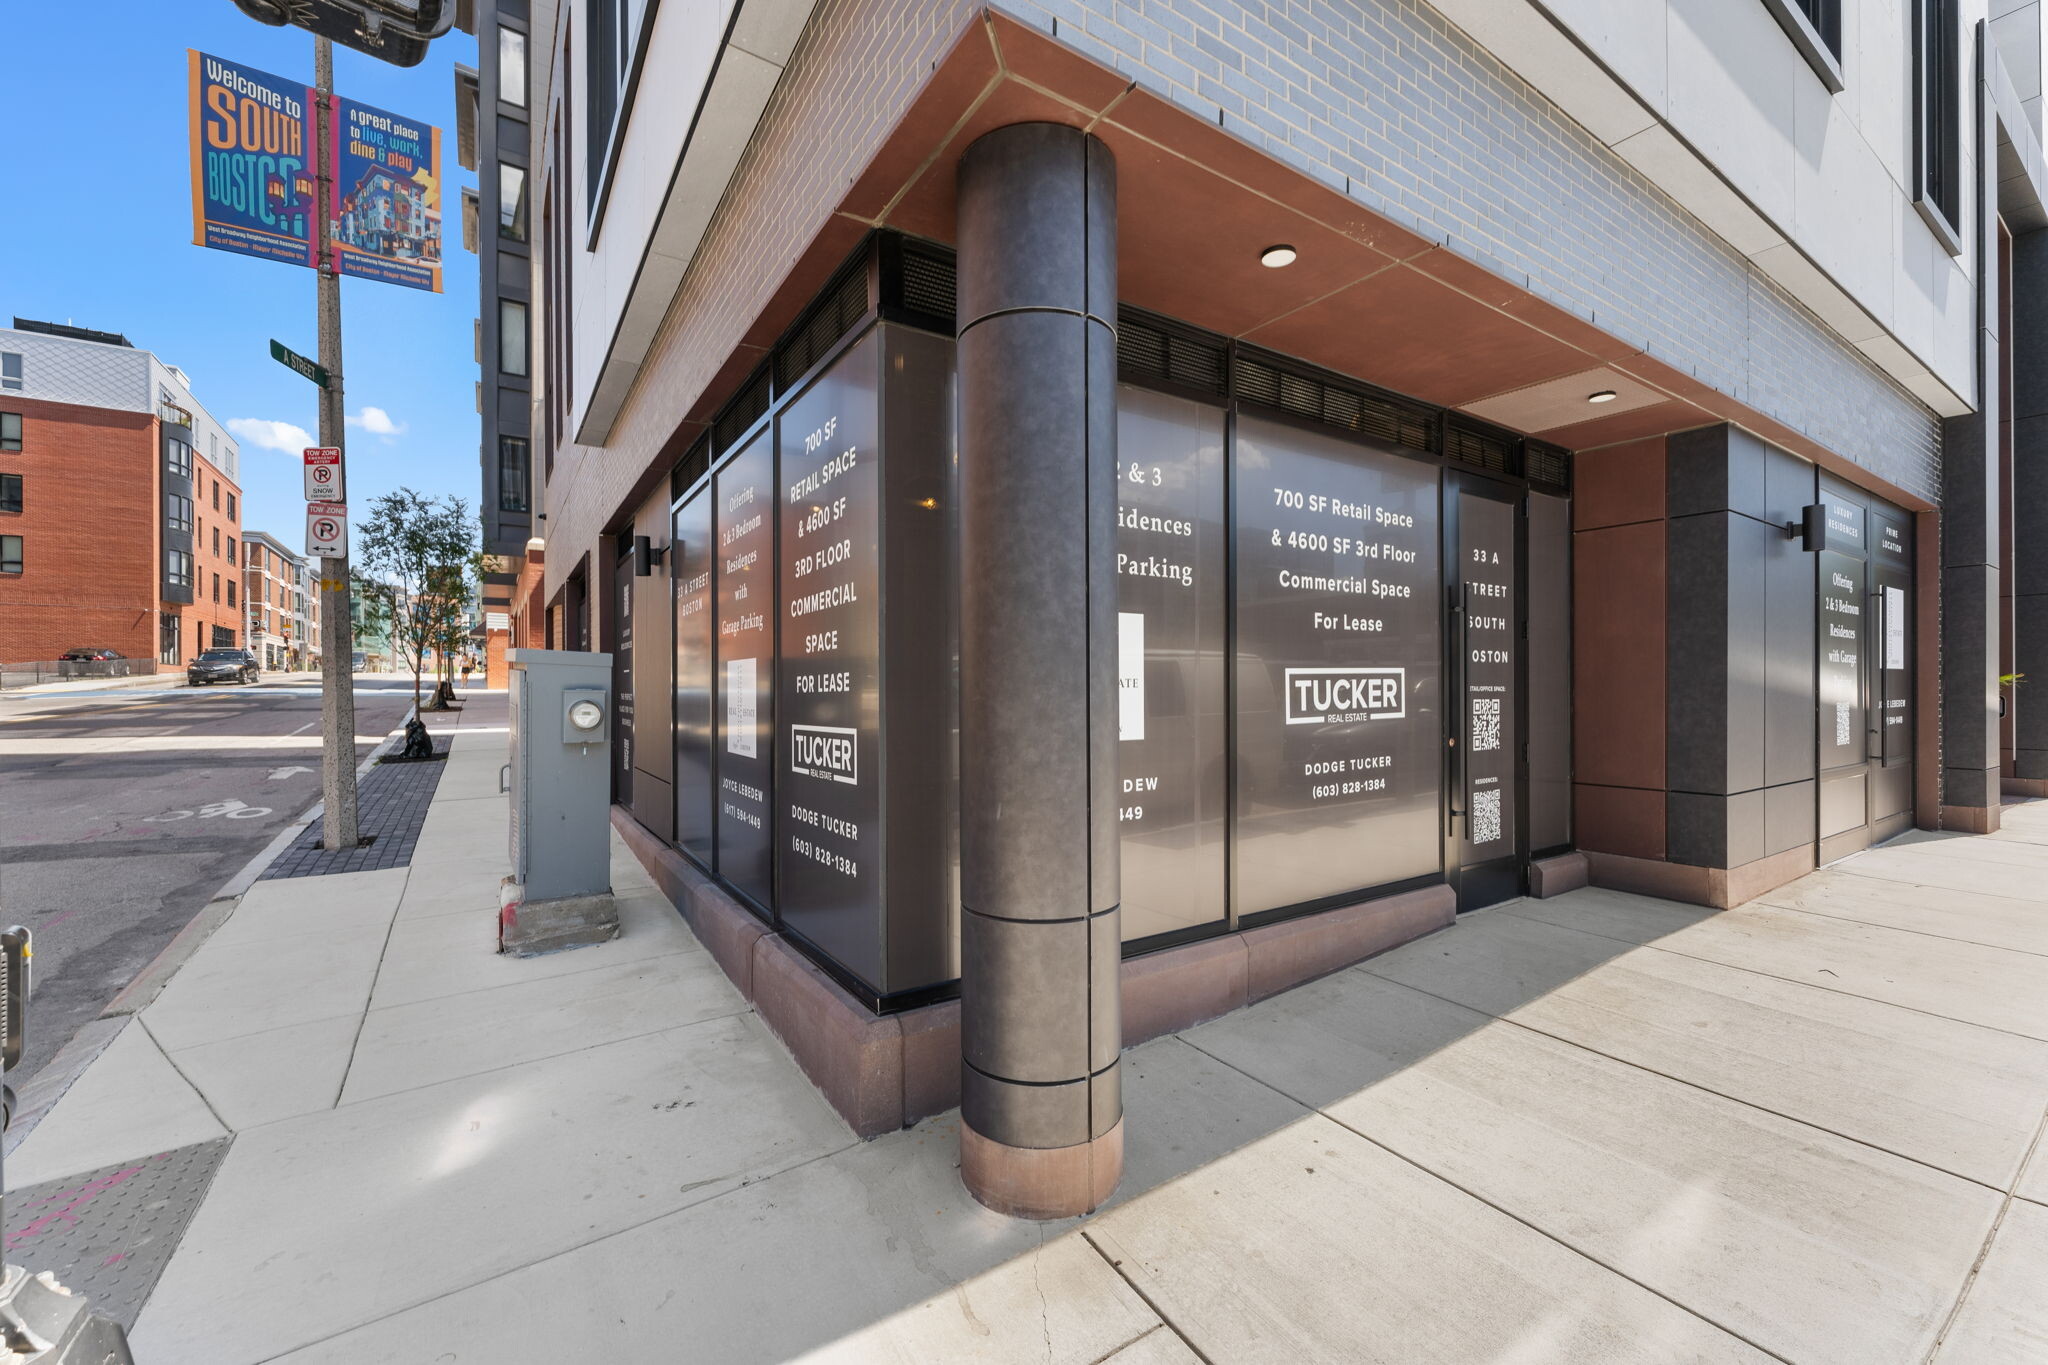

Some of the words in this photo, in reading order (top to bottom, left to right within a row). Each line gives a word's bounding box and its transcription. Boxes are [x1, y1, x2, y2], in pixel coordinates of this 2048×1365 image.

[206, 58, 281, 109] Welcome
[286, 96, 300, 119] to
[207, 84, 301, 156] SOUTH
[350, 109, 356, 122] A
[359, 111, 392, 132] great
[394, 124, 418, 141] place
[350, 125, 360, 139] to
[350, 140, 376, 160] dine
[378, 147, 385, 162] &
[388, 152, 412, 172] play
[207, 224, 221, 233] West
[221, 227, 246, 239] Broadway
[209, 235, 222, 244] City
[229, 239, 249, 249] Boston
[284, 349, 289, 366] A
[291, 353, 315, 381] STREET
[805, 428, 822, 455] 700
[824, 416, 837, 441] SF
[790, 471, 820, 504] RETAIL
[822, 446, 856, 484] SPACE
[1128, 462, 1145, 484] &
[1152, 467, 1162, 486] 3
[326, 506, 344, 514] ZONE
[729, 487, 754, 512] Offering
[1274, 488, 1304, 509] 700
[1309, 494, 1327, 512] SF
[1332, 498, 1371, 521] Retail
[1375, 507, 1413, 528] Space
[798, 519, 804, 538] &
[806, 506, 830, 533] 4600
[833, 497, 846, 520] SF
[1118, 506, 1192, 536] idences
[1833, 504, 1853, 519] LUXURY
[727, 530, 731, 545] &
[731, 528, 735, 542] 3
[735, 514, 761, 539] Bedroom
[1828, 518, 1858, 538] RESIDENCES
[1886, 526, 1898, 539] PRIME
[1271, 529, 1282, 546] &
[1287, 531, 1328, 553] 4600
[1333, 537, 1351, 554] SF
[1356, 540, 1378, 559] 3rd
[1383, 544, 1416, 563] Floor
[1473, 549, 1487, 562] 33
[1492, 552, 1499, 565] A
[1882, 539, 1902, 553] LOCATION
[726, 550, 757, 575] Residences
[795, 555, 813, 578] 3RD
[816, 539, 850, 570] FLOOR
[1117, 553, 1193, 586] Parking
[689, 572, 709, 593] STREET
[735, 583, 748, 600] with
[1279, 569, 1367, 595] Commercial
[1372, 579, 1411, 599] Space
[1466, 581, 1507, 598] TREET
[1832, 572, 1853, 593] Offering
[682, 597, 703, 617] BOSTON
[790, 581, 857, 618] COMMERCIAL
[1825, 597, 1829, 609] 2
[1830, 597, 1834, 610] &
[1835, 599, 1838, 611] 3
[1839, 599, 1859, 615] Bedroom
[722, 618, 740, 637] Garage
[740, 613, 764, 632] Parking
[1314, 612, 1338, 630] For
[1343, 614, 1383, 632] Lease
[1830, 623, 1856, 639] Residences
[805, 630, 838, 654] SPACE
[1472, 650, 1508, 663] OSTON
[1828, 649, 1840, 662] with
[1840, 650, 1857, 667] Garage
[796, 675, 815, 693] FOR
[817, 672, 850, 692] LEASE
[1119, 678, 1139, 688] ATE
[1294, 678, 1398, 712] TUCKER
[1327, 713, 1344, 723] REAL
[1345, 712, 1367, 722] ESTATE
[795, 735, 852, 772] TUCKER
[810, 768, 819, 778] REAL
[819, 770, 832, 781] ESTATE
[1305, 760, 1345, 775] DODGE
[1350, 755, 1392, 771] TUCKER
[722, 777, 737, 792] JOYCE
[738, 783, 763, 803] LEBEDEW
[1312, 783, 1339, 799] (603)
[1342, 778, 1386, 794] 828-1384
[736, 808, 760, 829] 594-1449
[791, 804, 819, 827] DODGE
[821, 814, 858, 841] TUCKER
[792, 835, 813, 859] (603)
[815, 846, 857, 878] 828-1384
